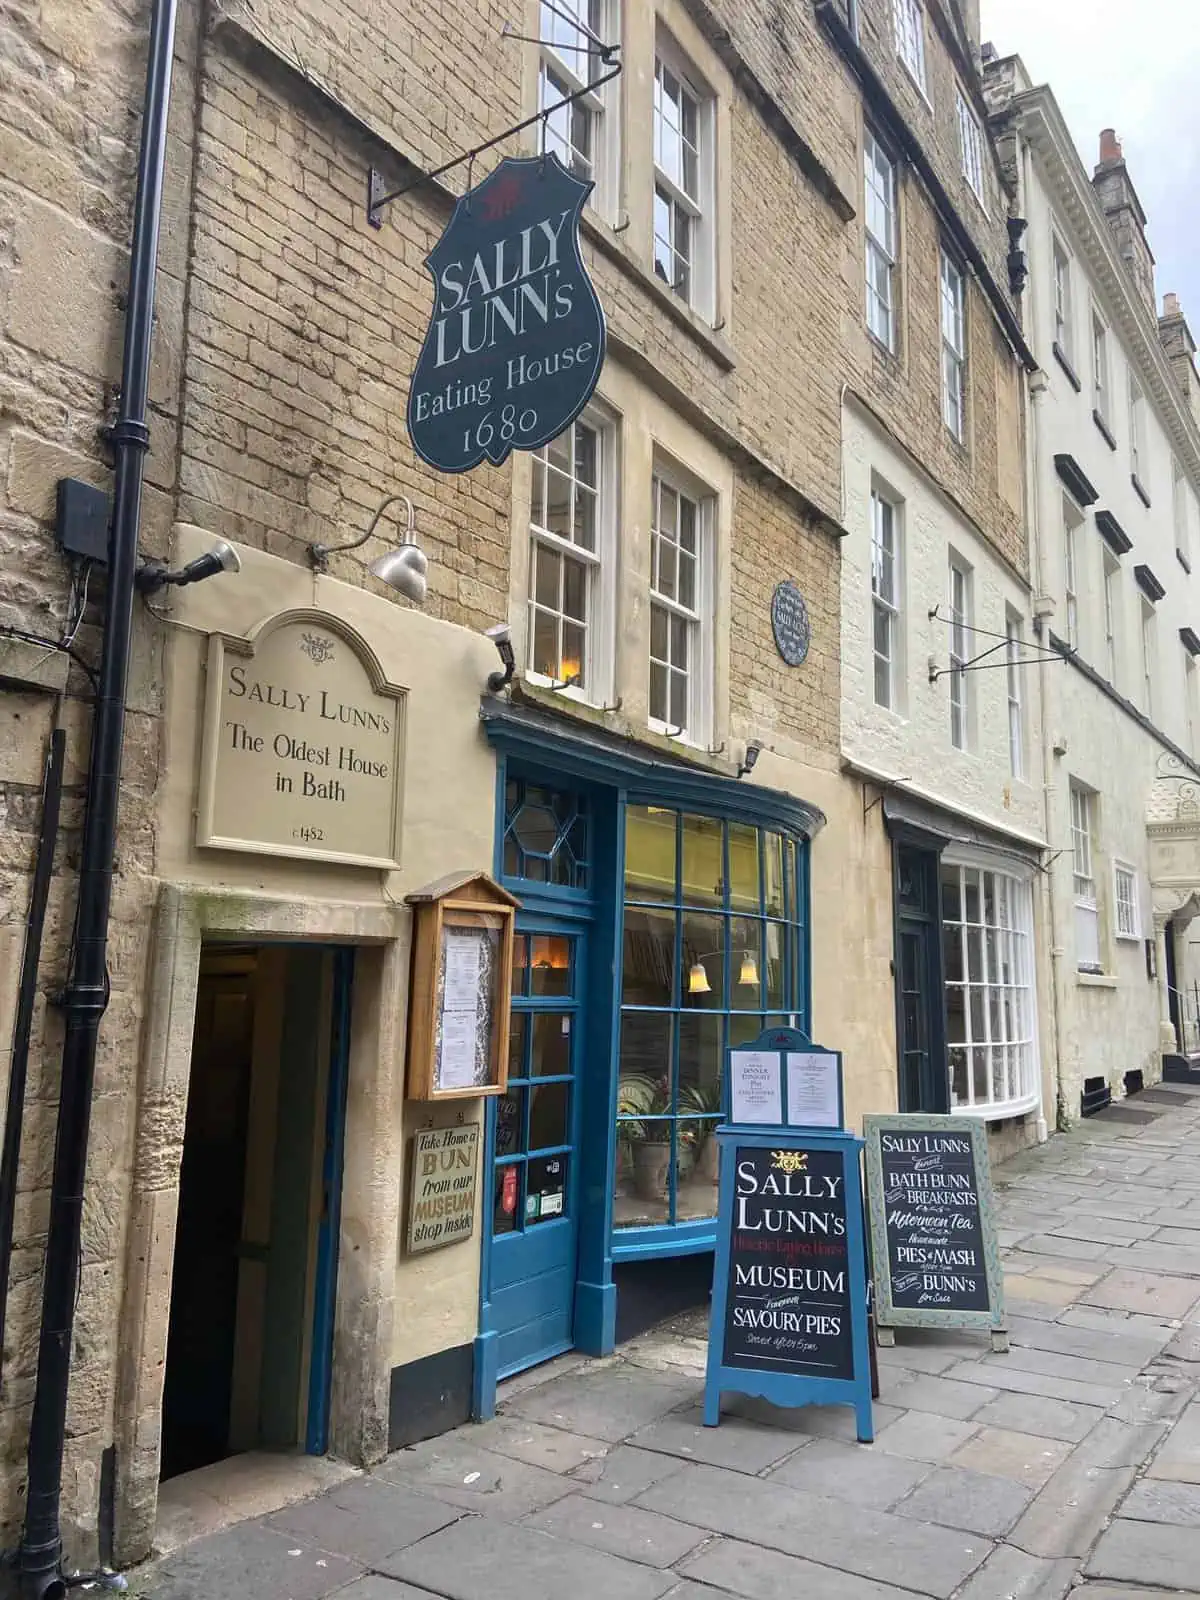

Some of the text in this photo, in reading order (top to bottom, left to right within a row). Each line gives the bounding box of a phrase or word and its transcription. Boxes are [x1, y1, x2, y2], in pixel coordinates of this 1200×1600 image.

[440, 208, 572, 314] SALLY
[415, 341, 593, 423] Eating House
[463, 403, 538, 452] 1680
[228, 666, 310, 713] SALLY
[226, 720, 389, 778] The Oldest House
[275, 771, 346, 802] in Bath
[419, 1131, 476, 1151] Take Home a
[882, 1135, 922, 1153] SALLY
[421, 1146, 473, 1176] BUN
[422, 1175, 473, 1197] from our
[737, 1161, 842, 1199] SALLY
[889, 1172, 970, 1189] BATH BUNN
[414, 1191, 473, 1223] MUSEUM
[907, 1190, 977, 1206] BREAKFASTS
[413, 1213, 473, 1243] shop inside
[887, 1210, 974, 1230] Afternoon Tea
[896, 1246, 927, 1263] PIES
[933, 1248, 976, 1267] MASH
[735, 1264, 845, 1294] MUSEUM
[923, 1274, 977, 1292] BUNN's
[733, 1307, 841, 1336] SAVOURY PIES
